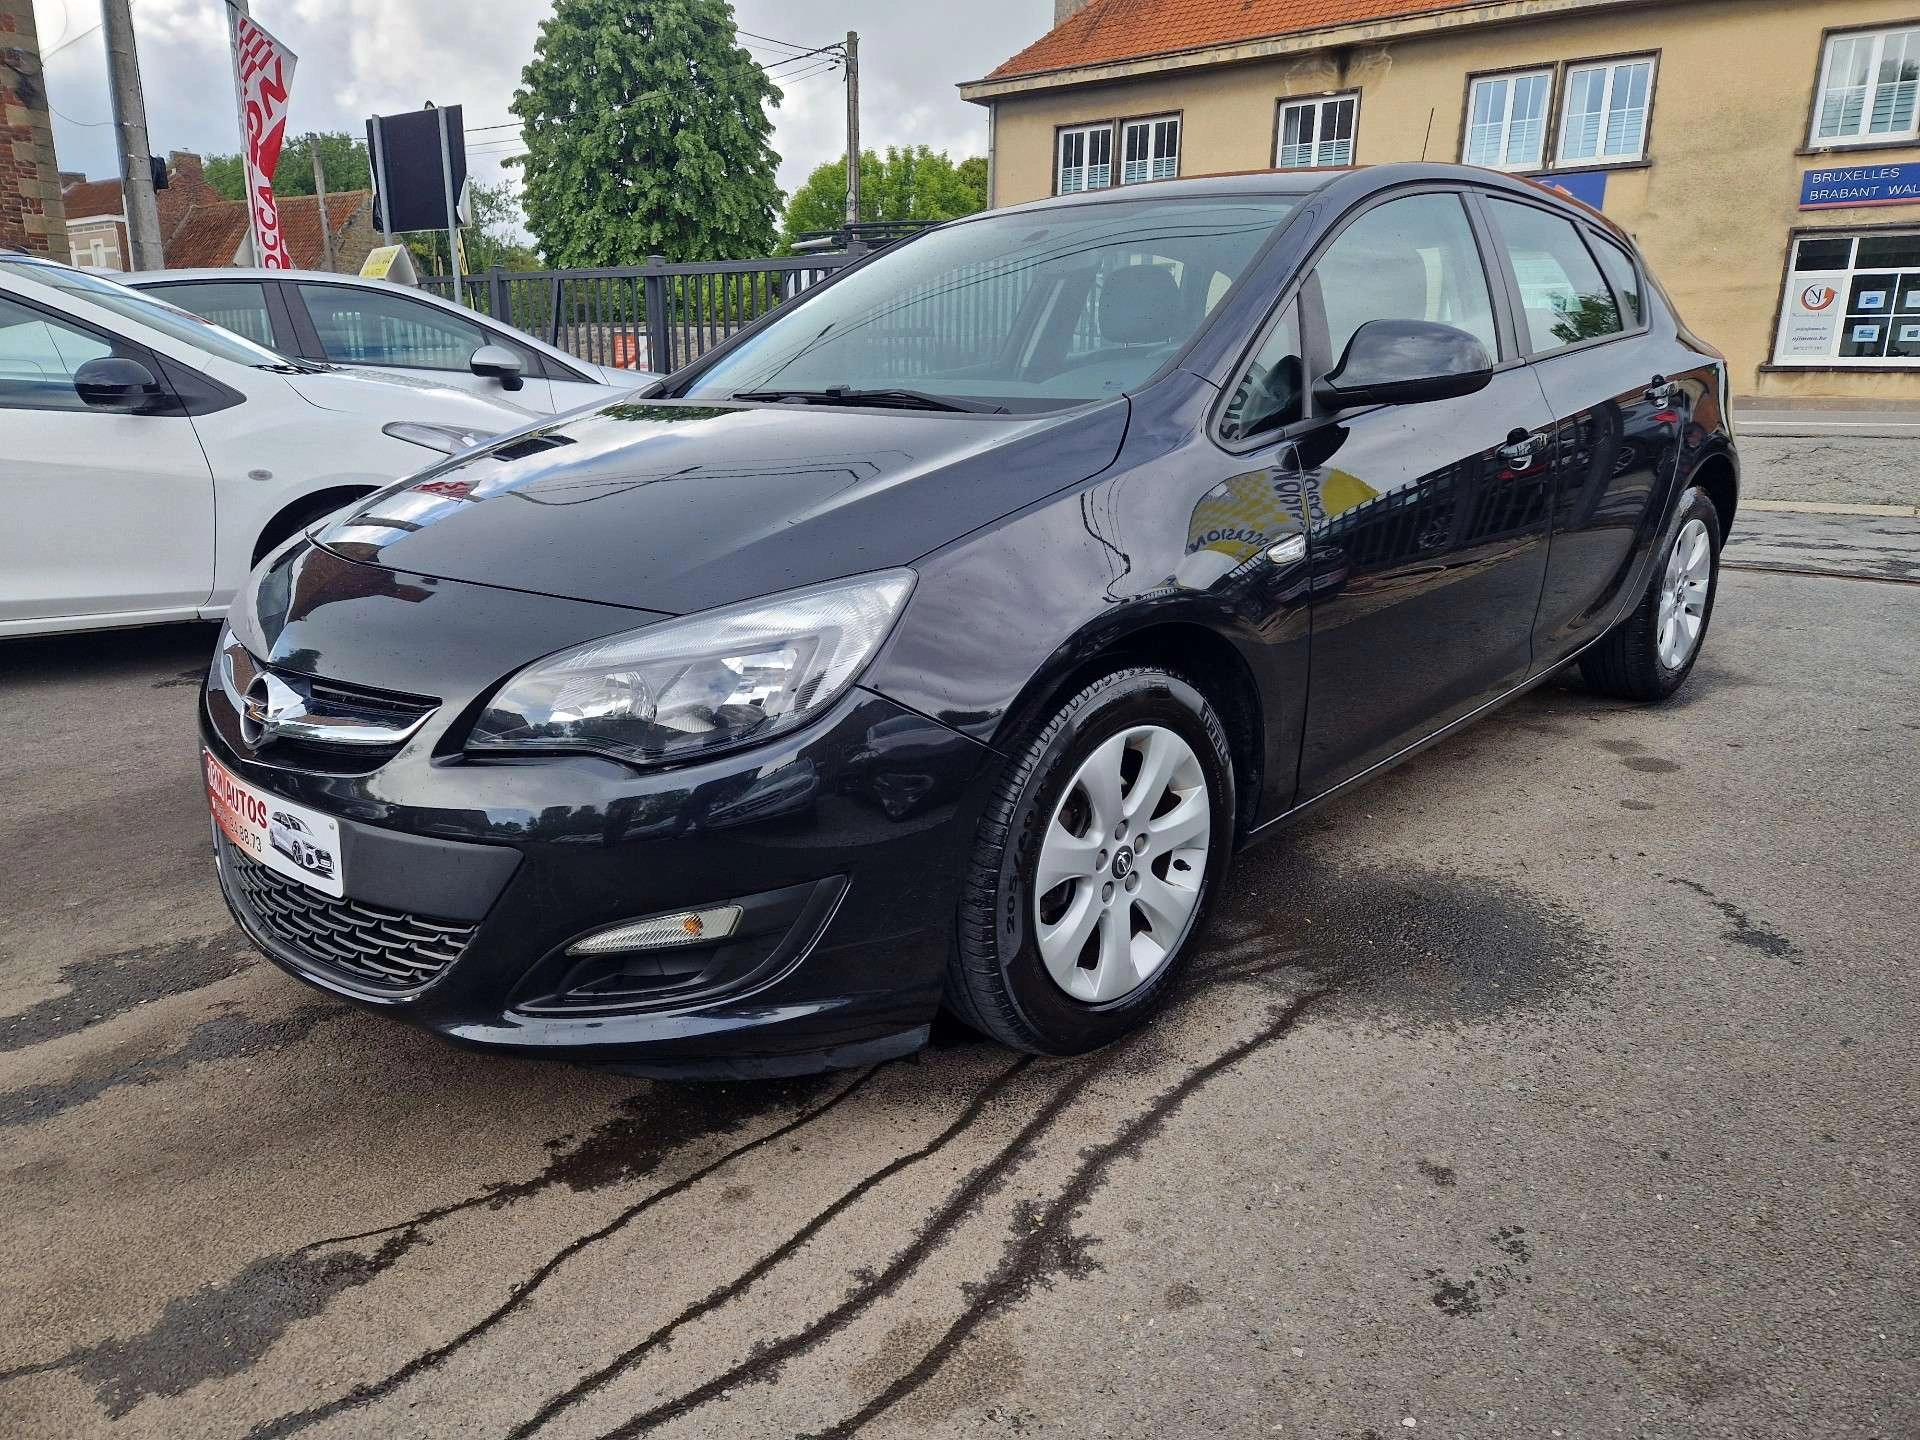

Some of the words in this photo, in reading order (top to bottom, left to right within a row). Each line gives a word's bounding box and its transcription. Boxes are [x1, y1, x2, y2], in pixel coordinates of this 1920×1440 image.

[1812, 167, 1901, 184] BRUXELLES
[1809, 185, 1880, 201] BRABANT
[225, 776, 267, 829] AUTOS
